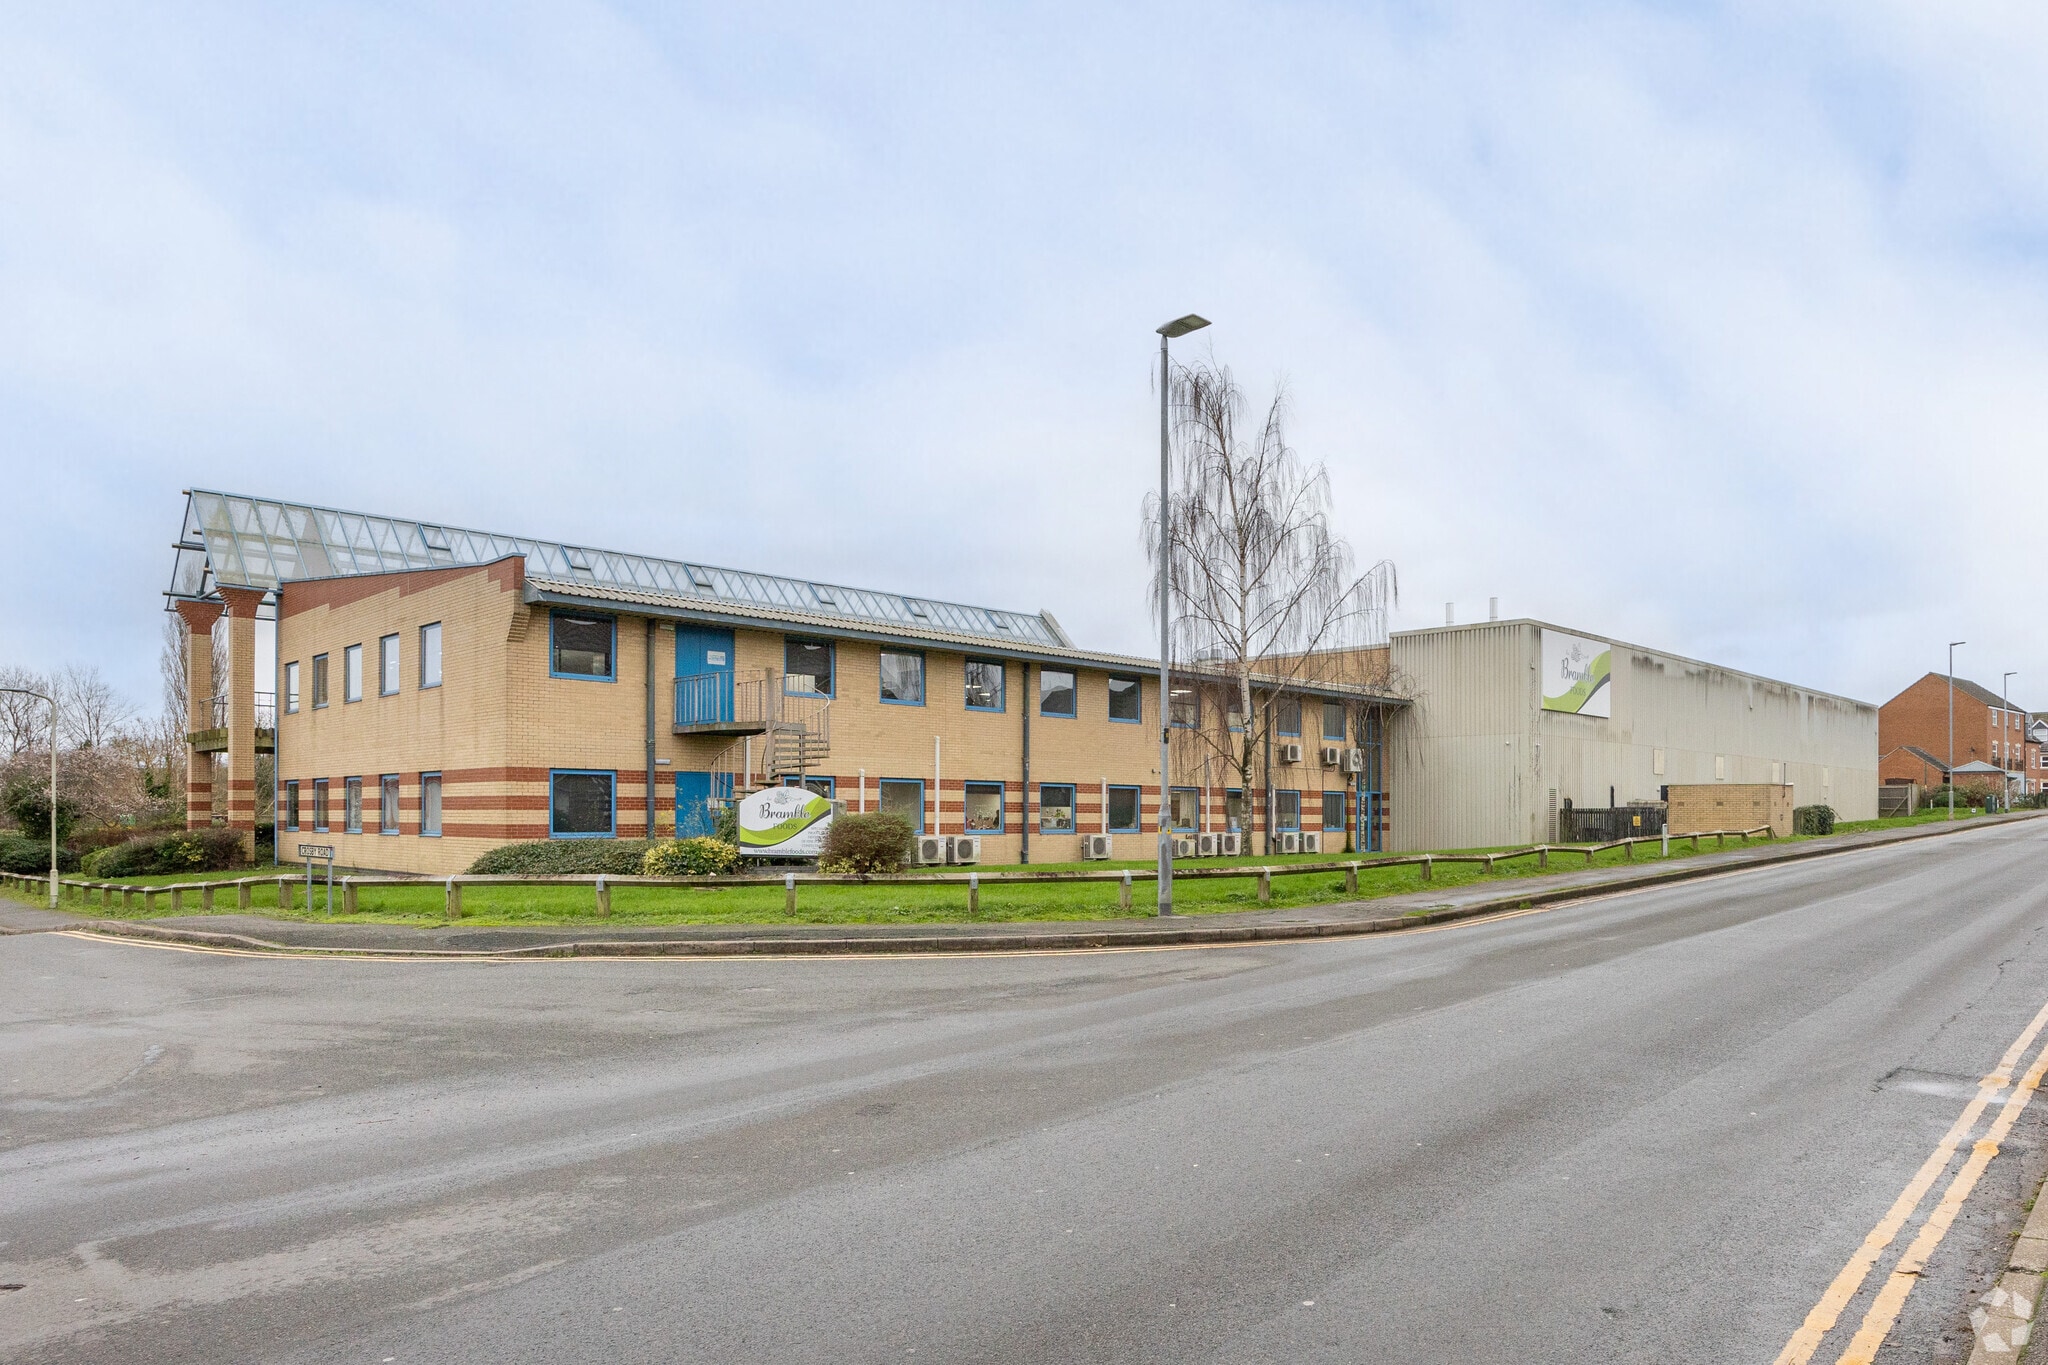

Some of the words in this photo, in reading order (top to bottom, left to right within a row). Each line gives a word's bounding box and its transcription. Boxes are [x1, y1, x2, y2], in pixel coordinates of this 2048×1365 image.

[1561, 657, 1595, 682] Bramble
[759, 802, 810, 819] Bramble
[773, 822, 797, 830] FOODS
[318, 847, 329, 857] ROAD
